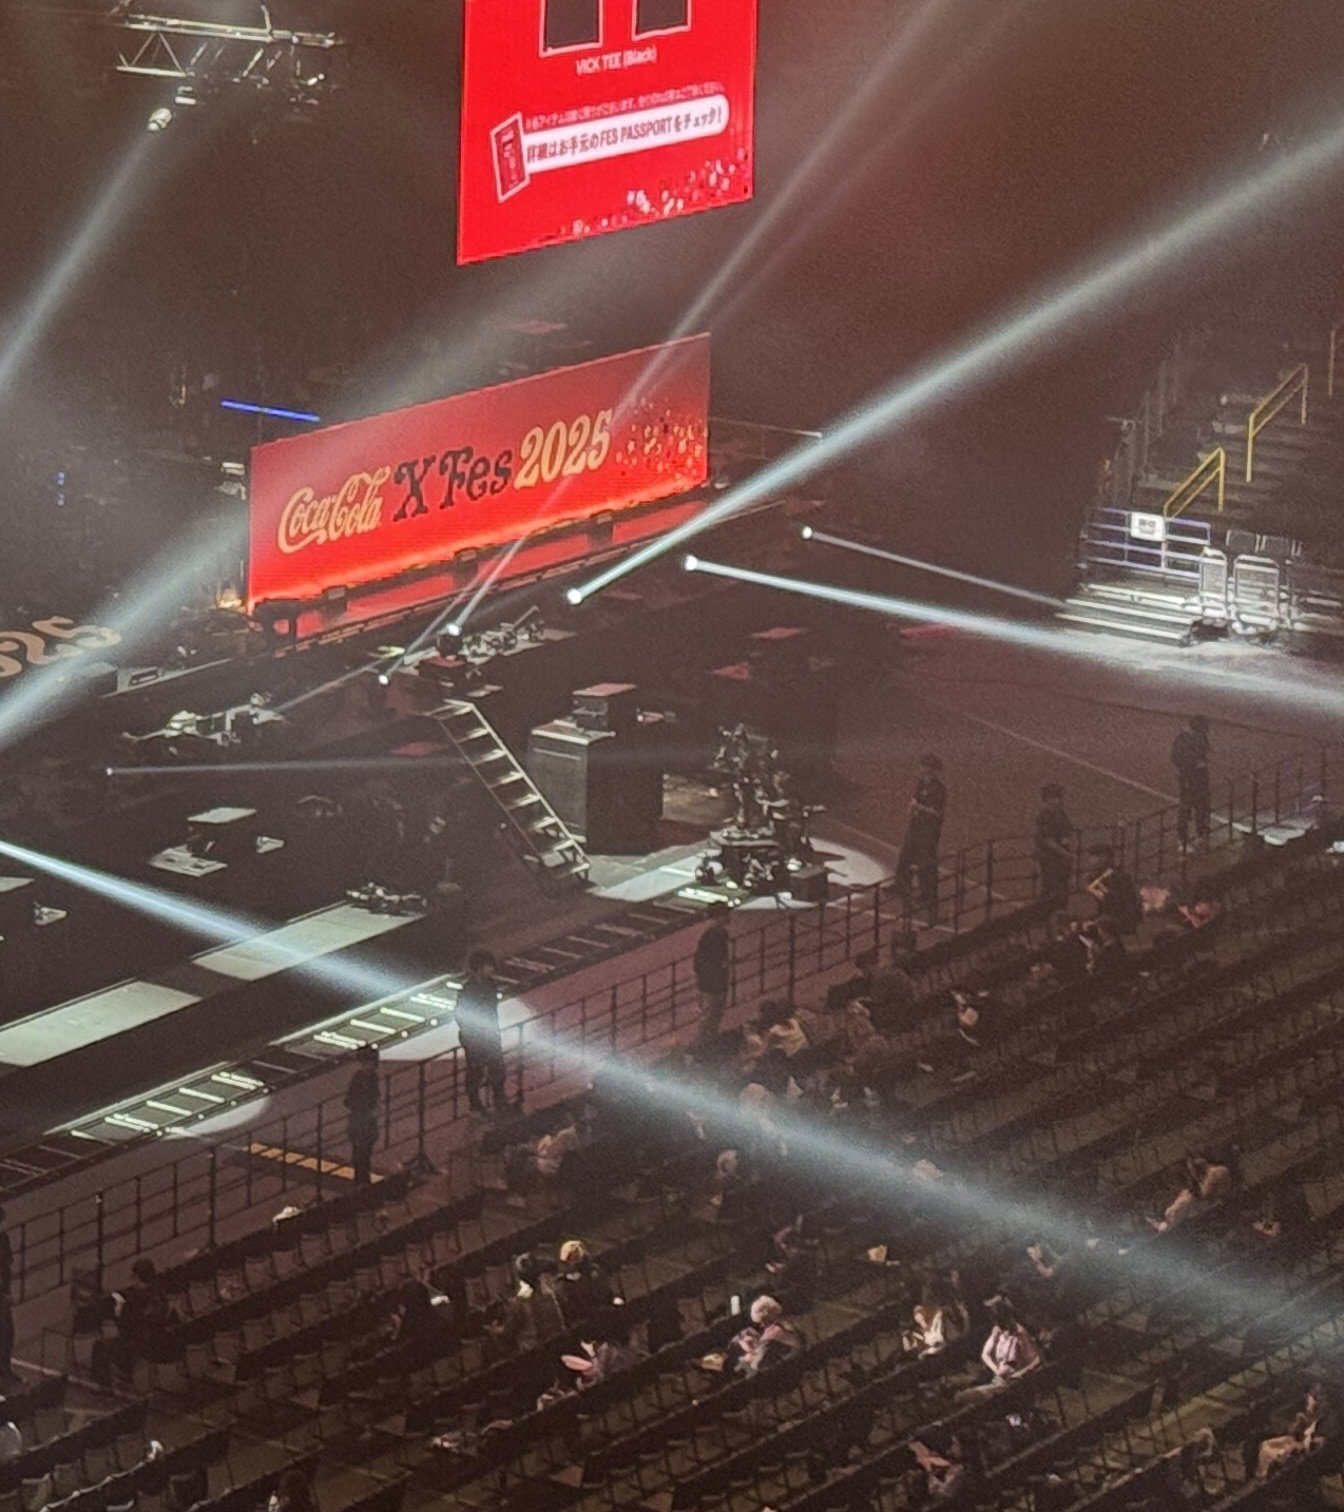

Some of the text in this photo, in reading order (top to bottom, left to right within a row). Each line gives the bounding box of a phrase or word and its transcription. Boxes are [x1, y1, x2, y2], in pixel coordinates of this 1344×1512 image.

[278, 408, 613, 554] Coca-Cola X Fes 2025
